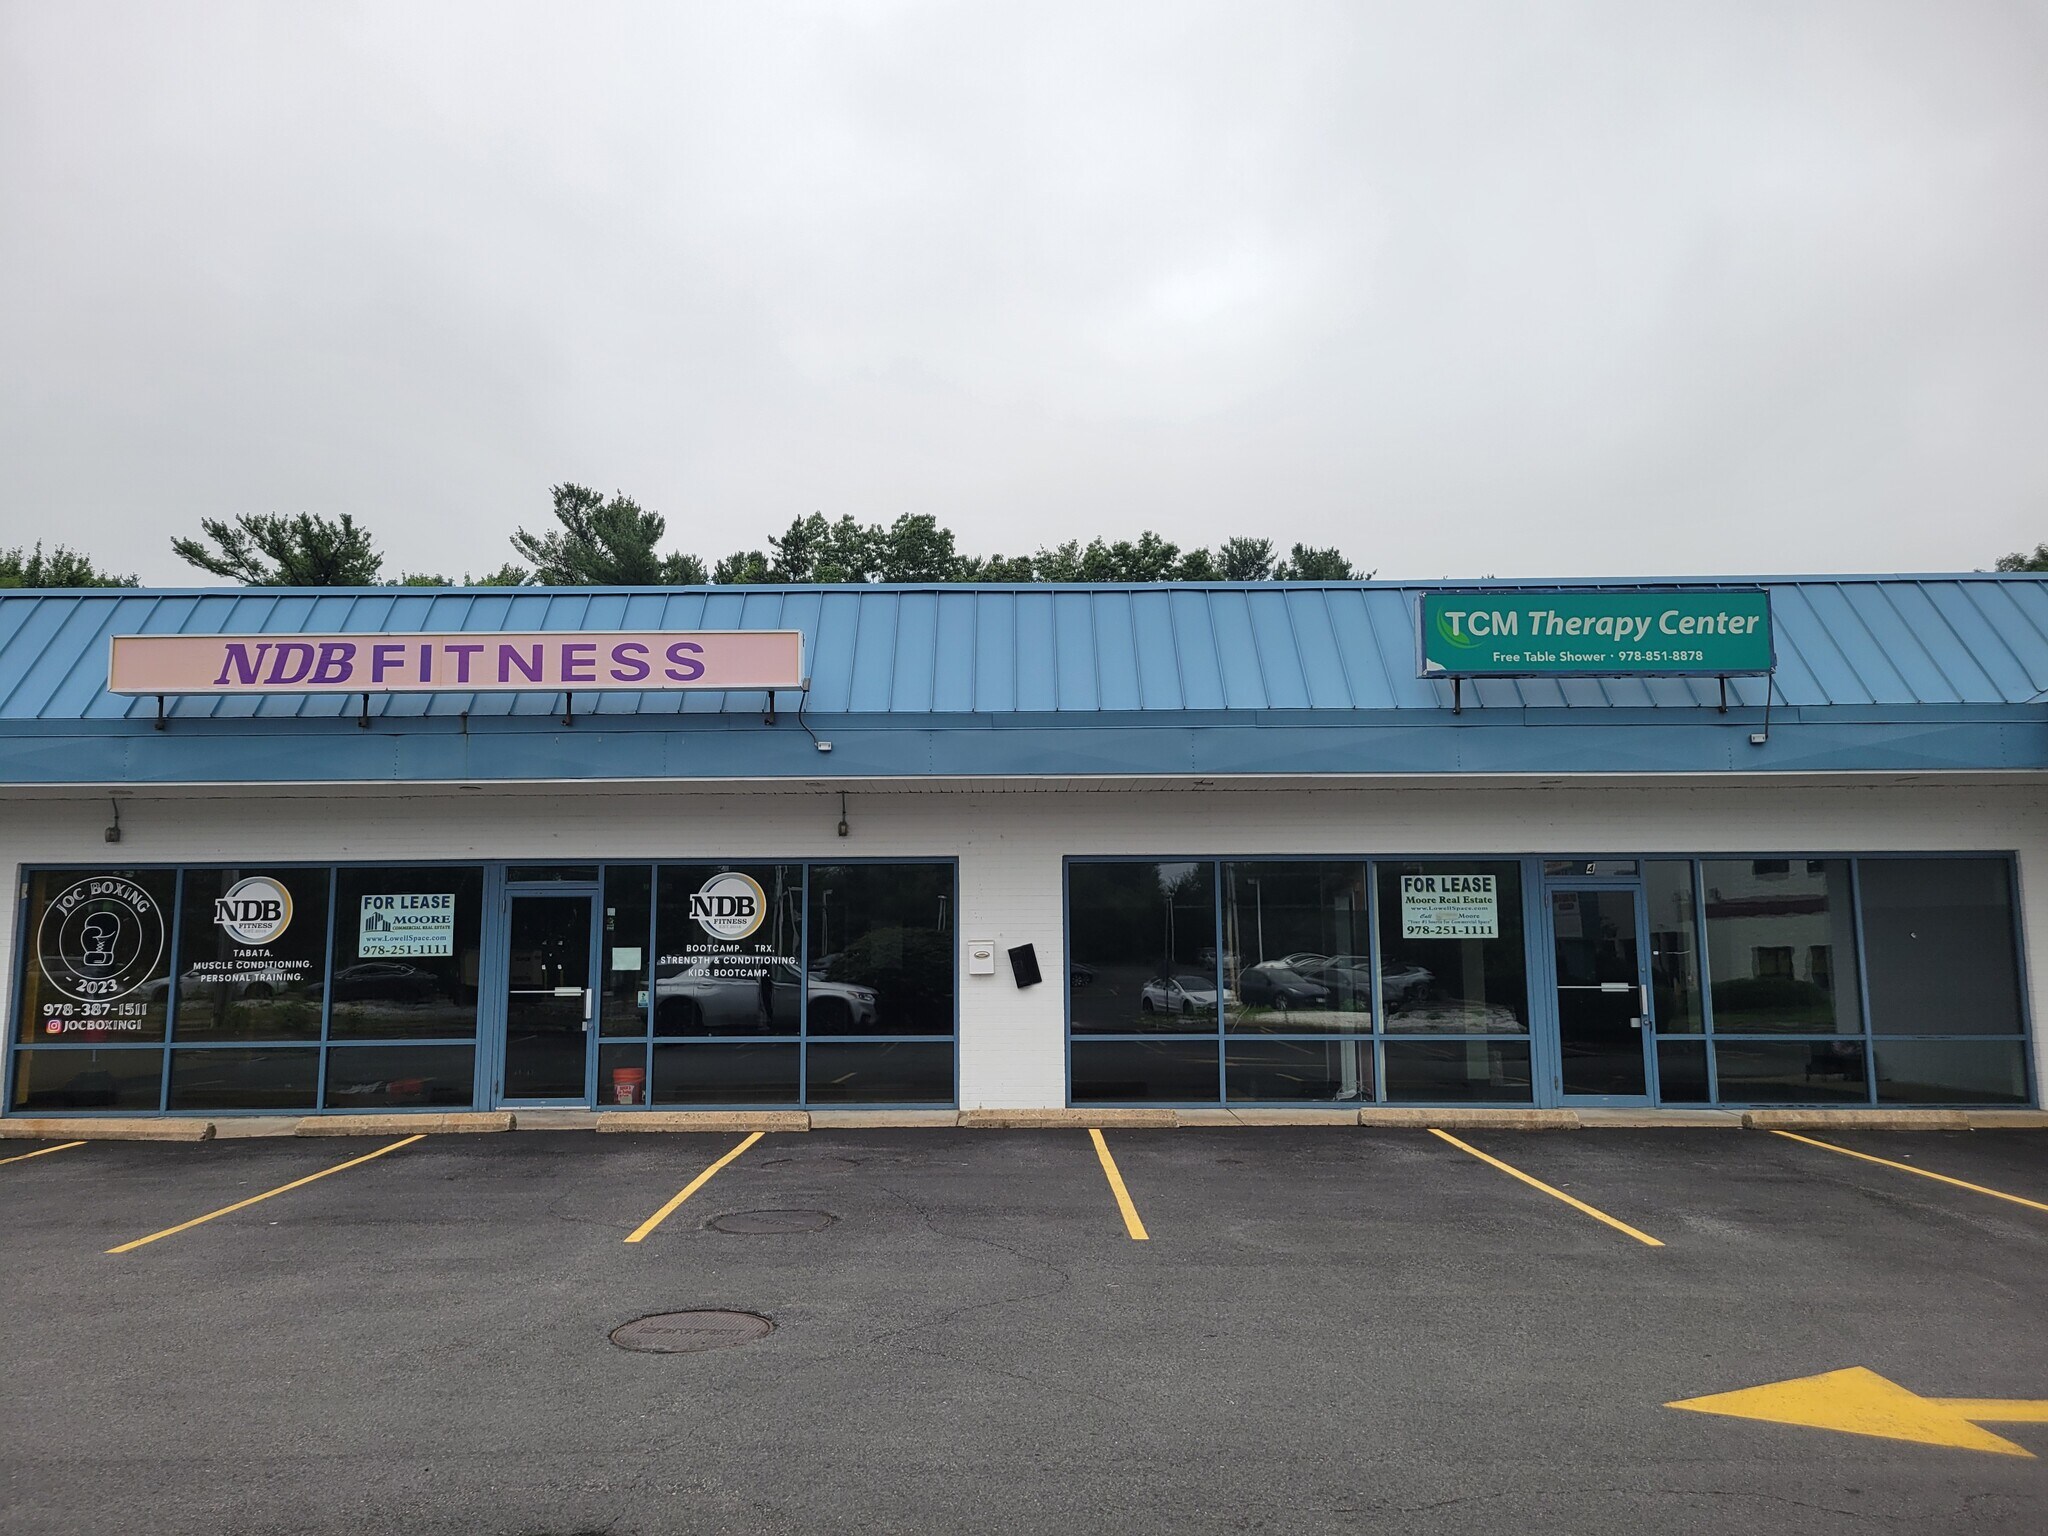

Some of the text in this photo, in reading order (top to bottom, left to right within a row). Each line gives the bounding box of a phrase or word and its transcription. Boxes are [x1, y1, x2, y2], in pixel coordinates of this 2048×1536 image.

[1445, 610, 1759, 642] TCM Therapy Center
[1493, 650, 1703, 663] Free Table Shower 978-851-8878
[213, 640, 706, 685] NDB FITNESS
[1587, 863, 1595, 873] 4
[1404, 877, 1492, 892] FOR LEASE
[56, 881, 150, 916] JOC BOXING
[364, 896, 450, 909] FOR LEASE
[1405, 896, 1492, 904] Moore Real Estate
[216, 900, 281, 921] NDB
[691, 896, 756, 917] NDB
[393, 915, 451, 924] MOORE
[1407, 926, 1493, 935] 978-251-1111
[233, 949, 274, 957] TABATA.
[363, 945, 448, 955] 978-251-1111
[686, 945, 775, 953] BOOTCAMP. TRX.
[193, 960, 313, 970] MUSCLE CONDITIONING.
[661, 956, 710, 964] STRENGTH
[724, 956, 799, 964] CONDITIONING.
[200, 973, 304, 982] PERSONAL TRAINING.
[688, 969, 770, 977] KIDS BOOTCAMP.
[76, 979, 118, 994] 2023
[43, 1003, 148, 1016] 978-387-1511
